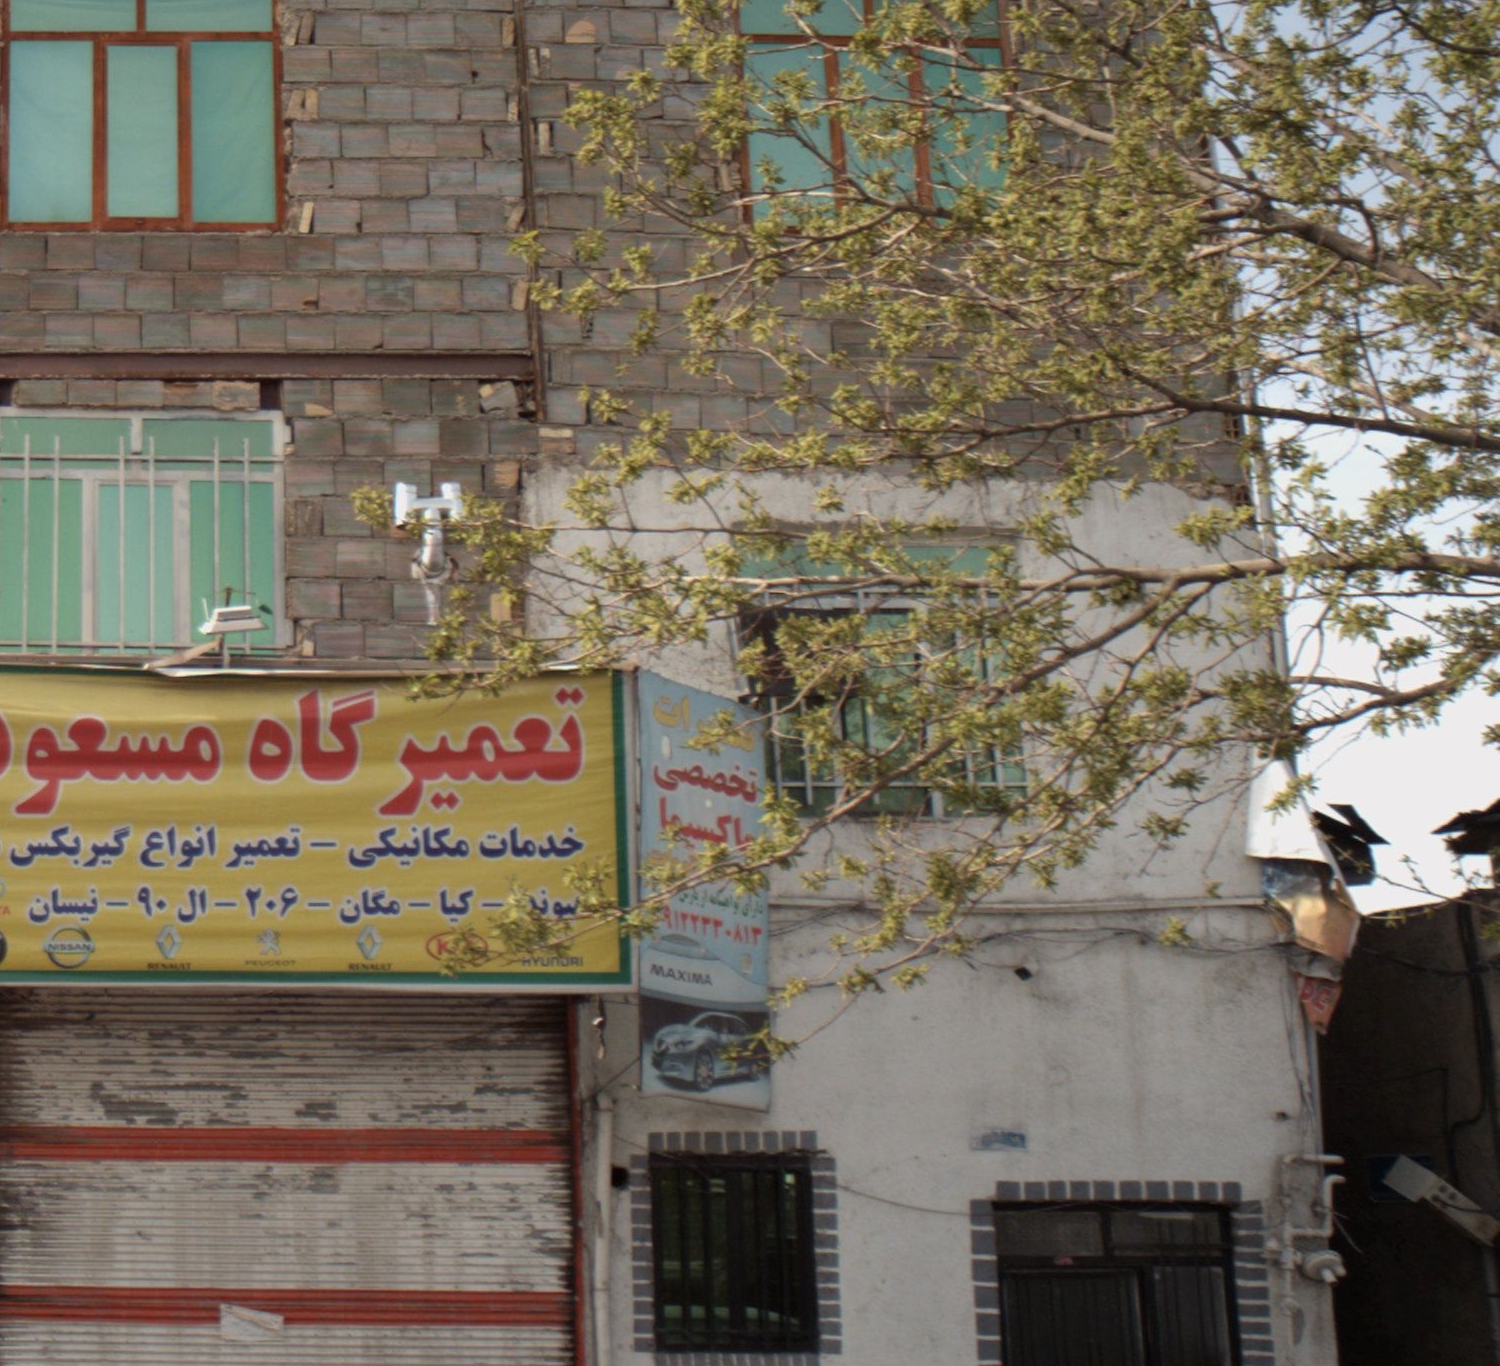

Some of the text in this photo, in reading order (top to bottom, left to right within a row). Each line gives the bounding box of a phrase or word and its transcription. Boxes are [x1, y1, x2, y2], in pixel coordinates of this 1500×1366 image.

[652, 764, 757, 803] تخصصی
[10, 825, 131, 867] گیربکس
[138, 826, 216, 867] انواع
[225, 827, 301, 868] تعمیر
[347, 826, 470, 867] مکانیکی
[478, 826, 585, 859] خدمات
[28, 887, 99, 923] نیسان
[136, 886, 167, 917] ۹۰
[177, 888, 208, 924] ال
[245, 887, 299, 918] ۲۰۶
[338, 889, 401, 924] مگان
[438, 888, 475, 923] کیا
[47, 943, 92, 951] NISSAN
[245, 959, 297, 967] PEUGEOT
[147, 962, 192, 971] RENAULT
[348, 962, 393, 971] RENAULT
[650, 963, 713, 986] MAXIMA
